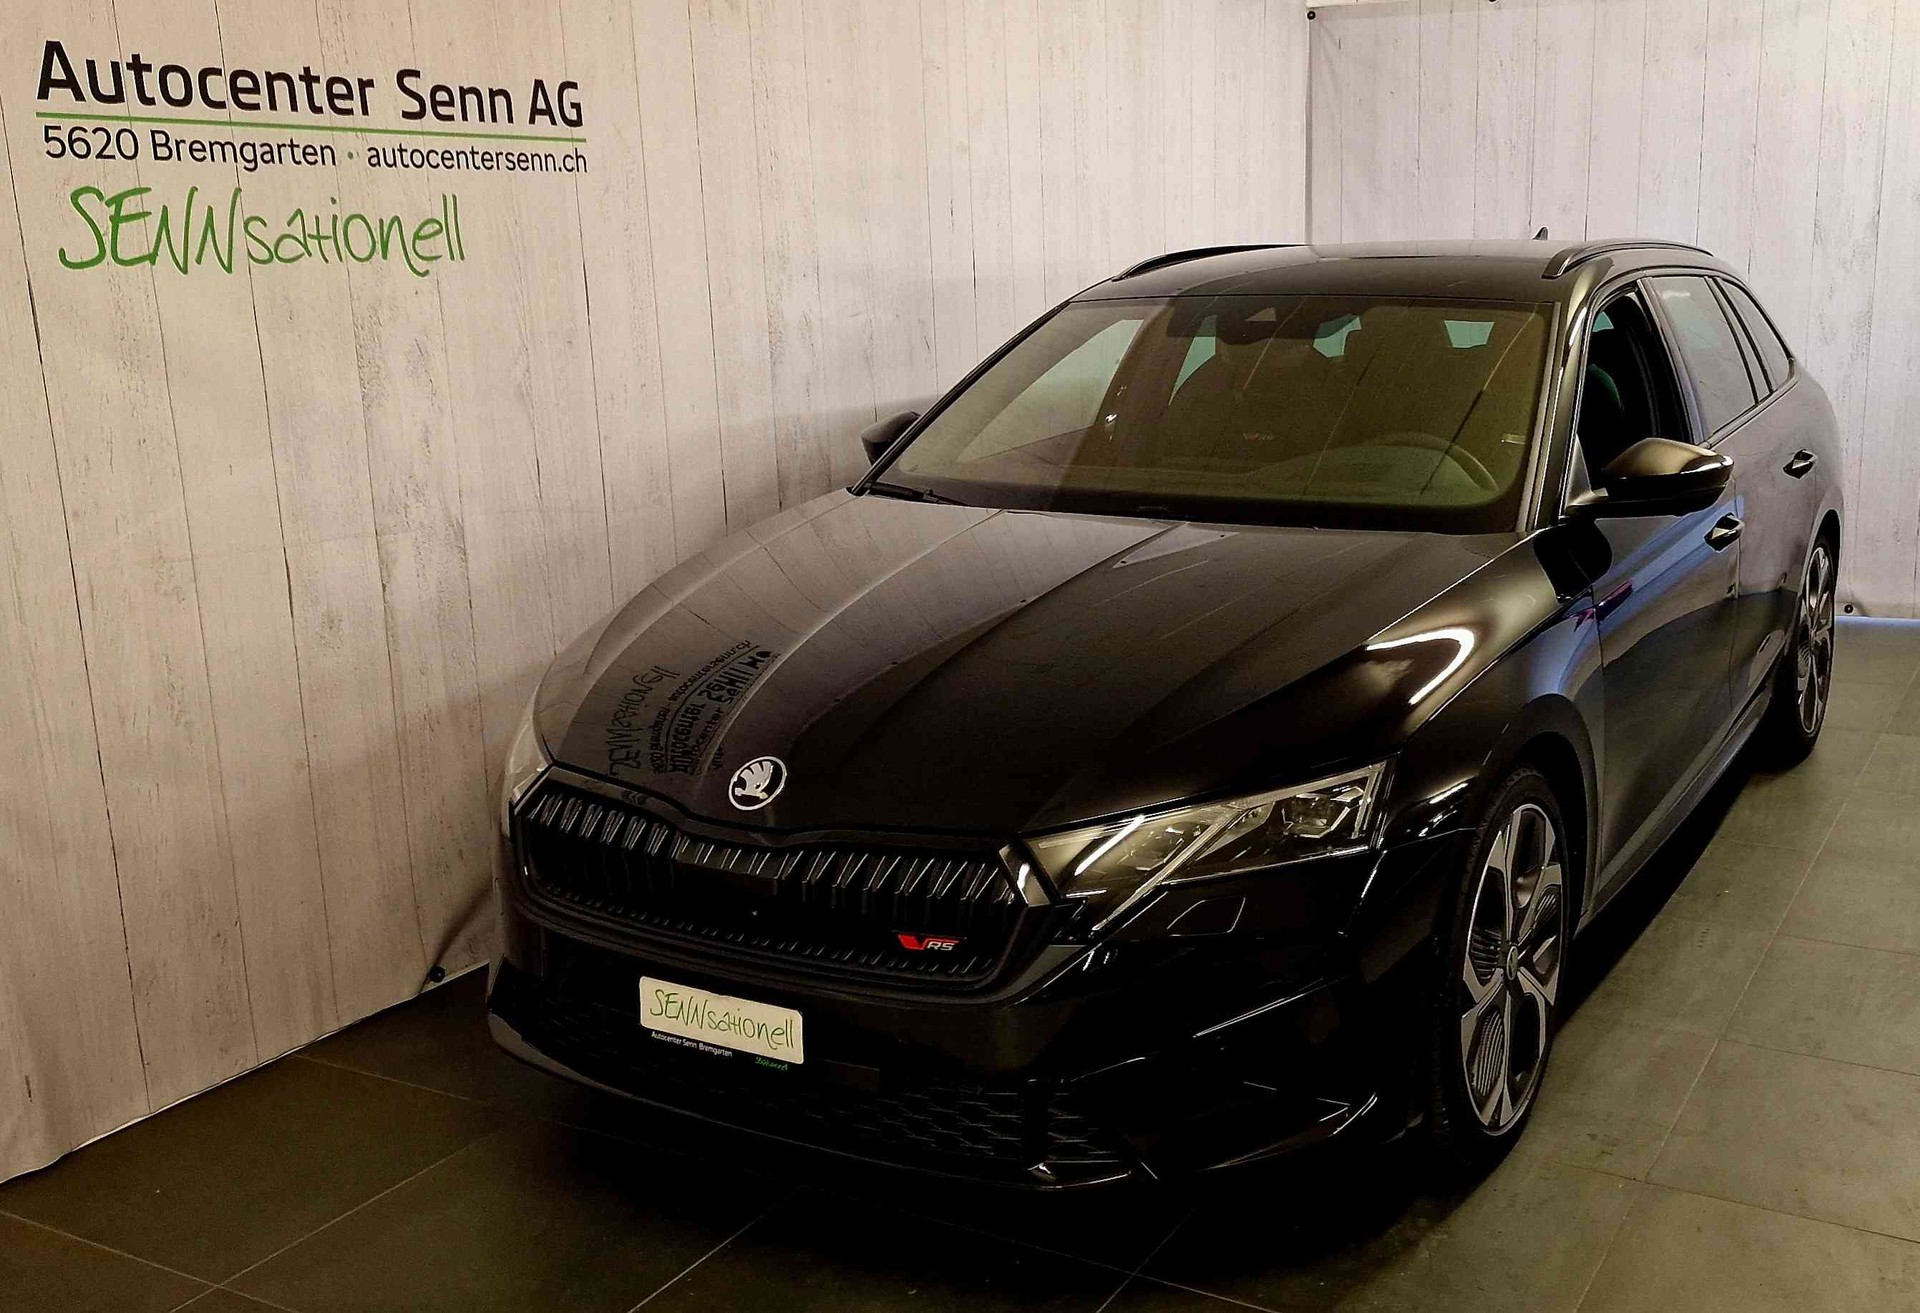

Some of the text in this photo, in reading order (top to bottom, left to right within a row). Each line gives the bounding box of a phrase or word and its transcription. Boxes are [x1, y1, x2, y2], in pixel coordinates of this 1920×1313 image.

[37, 40, 584, 127] Autocenter Senn AG
[44, 125, 587, 173] 5620 Bremgarten autocentersenn.ch
[58, 186, 466, 277] SENNsationell
[649, 989, 794, 1050] SENNsationell
[651, 1031, 733, 1058] Autocenter Senn Bremgarten
